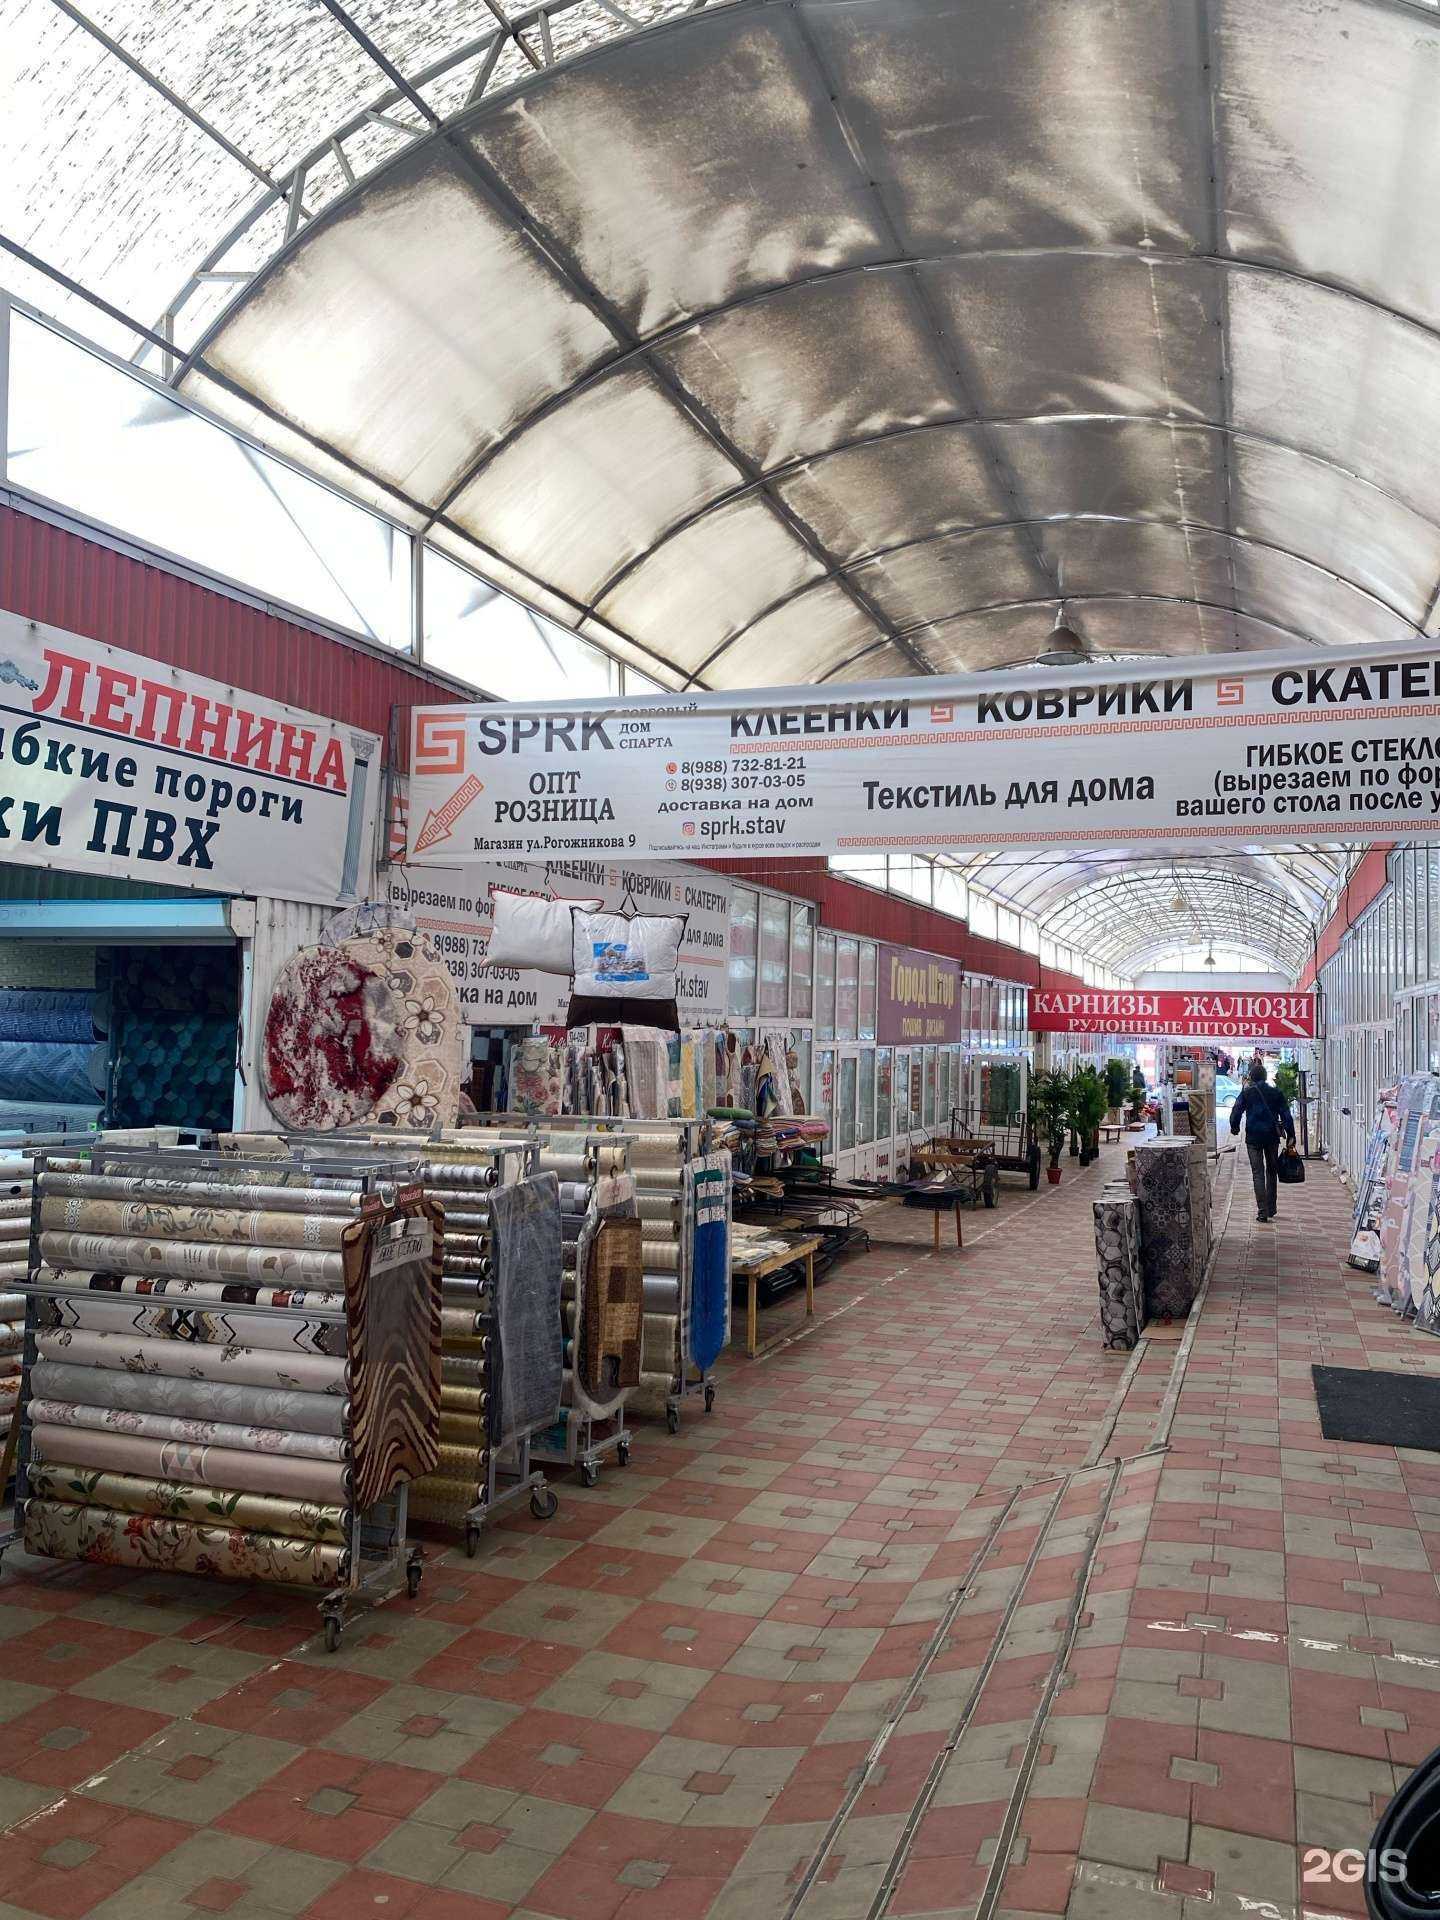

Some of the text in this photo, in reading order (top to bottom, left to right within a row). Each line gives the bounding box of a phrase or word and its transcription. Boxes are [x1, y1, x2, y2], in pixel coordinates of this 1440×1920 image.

[977, 678, 1193, 723] КОВРИКИ
[1271, 661, 1440, 706] СКАТЕ
[32, 649, 347, 791] ЛЕПНИНА
[478, 710, 617, 756] SPRK
[619, 722, 651, 736] ДОМ
[619, 737, 673, 750] СПАРТА
[1246, 741, 1344, 768] ГИБКОЕ
[0, 721, 303, 825] бкие пороги
[681, 757, 807, 777] 8(988) 732-81-21
[529, 770, 581, 795] ОПТ
[681, 774, 806, 794] 8(938) 307-03-05
[863, 775, 1155, 811] Текстиль для дома
[1214, 769, 1351, 798] (вырезаем
[1360, 767, 1390, 787] по
[494, 797, 616, 825] РОЗНИЦА
[657, 796, 814, 814] доставка на дом
[1176, 796, 1266, 817] вашего
[1273, 793, 1341, 813] стола
[1350, 790, 1423, 811] после
[86, 798, 220, 870] ПВХ
[700, 815, 786, 841] sprk.stav
[473, 834, 636, 853] Магазин ул.Рогожникова 9
[388, 881, 456, 909] (вырезаем
[459, 898, 473, 911] по
[622, 870, 671, 901] КОВРИКИ
[684, 886, 727, 913] СКАТЕРТИ
[434, 934, 469, 958] 8(988)
[686, 928, 724, 947] для дома
[890, 956, 927, 1009] Город
[455, 985, 538, 1008] ка на дом
[1033, 993, 1310, 1019] КАРНИЗЫ ЖАЛЮЗИ
[1067, 1018, 1269, 1037] РУЛОННЫЕ ШТОРЫ
